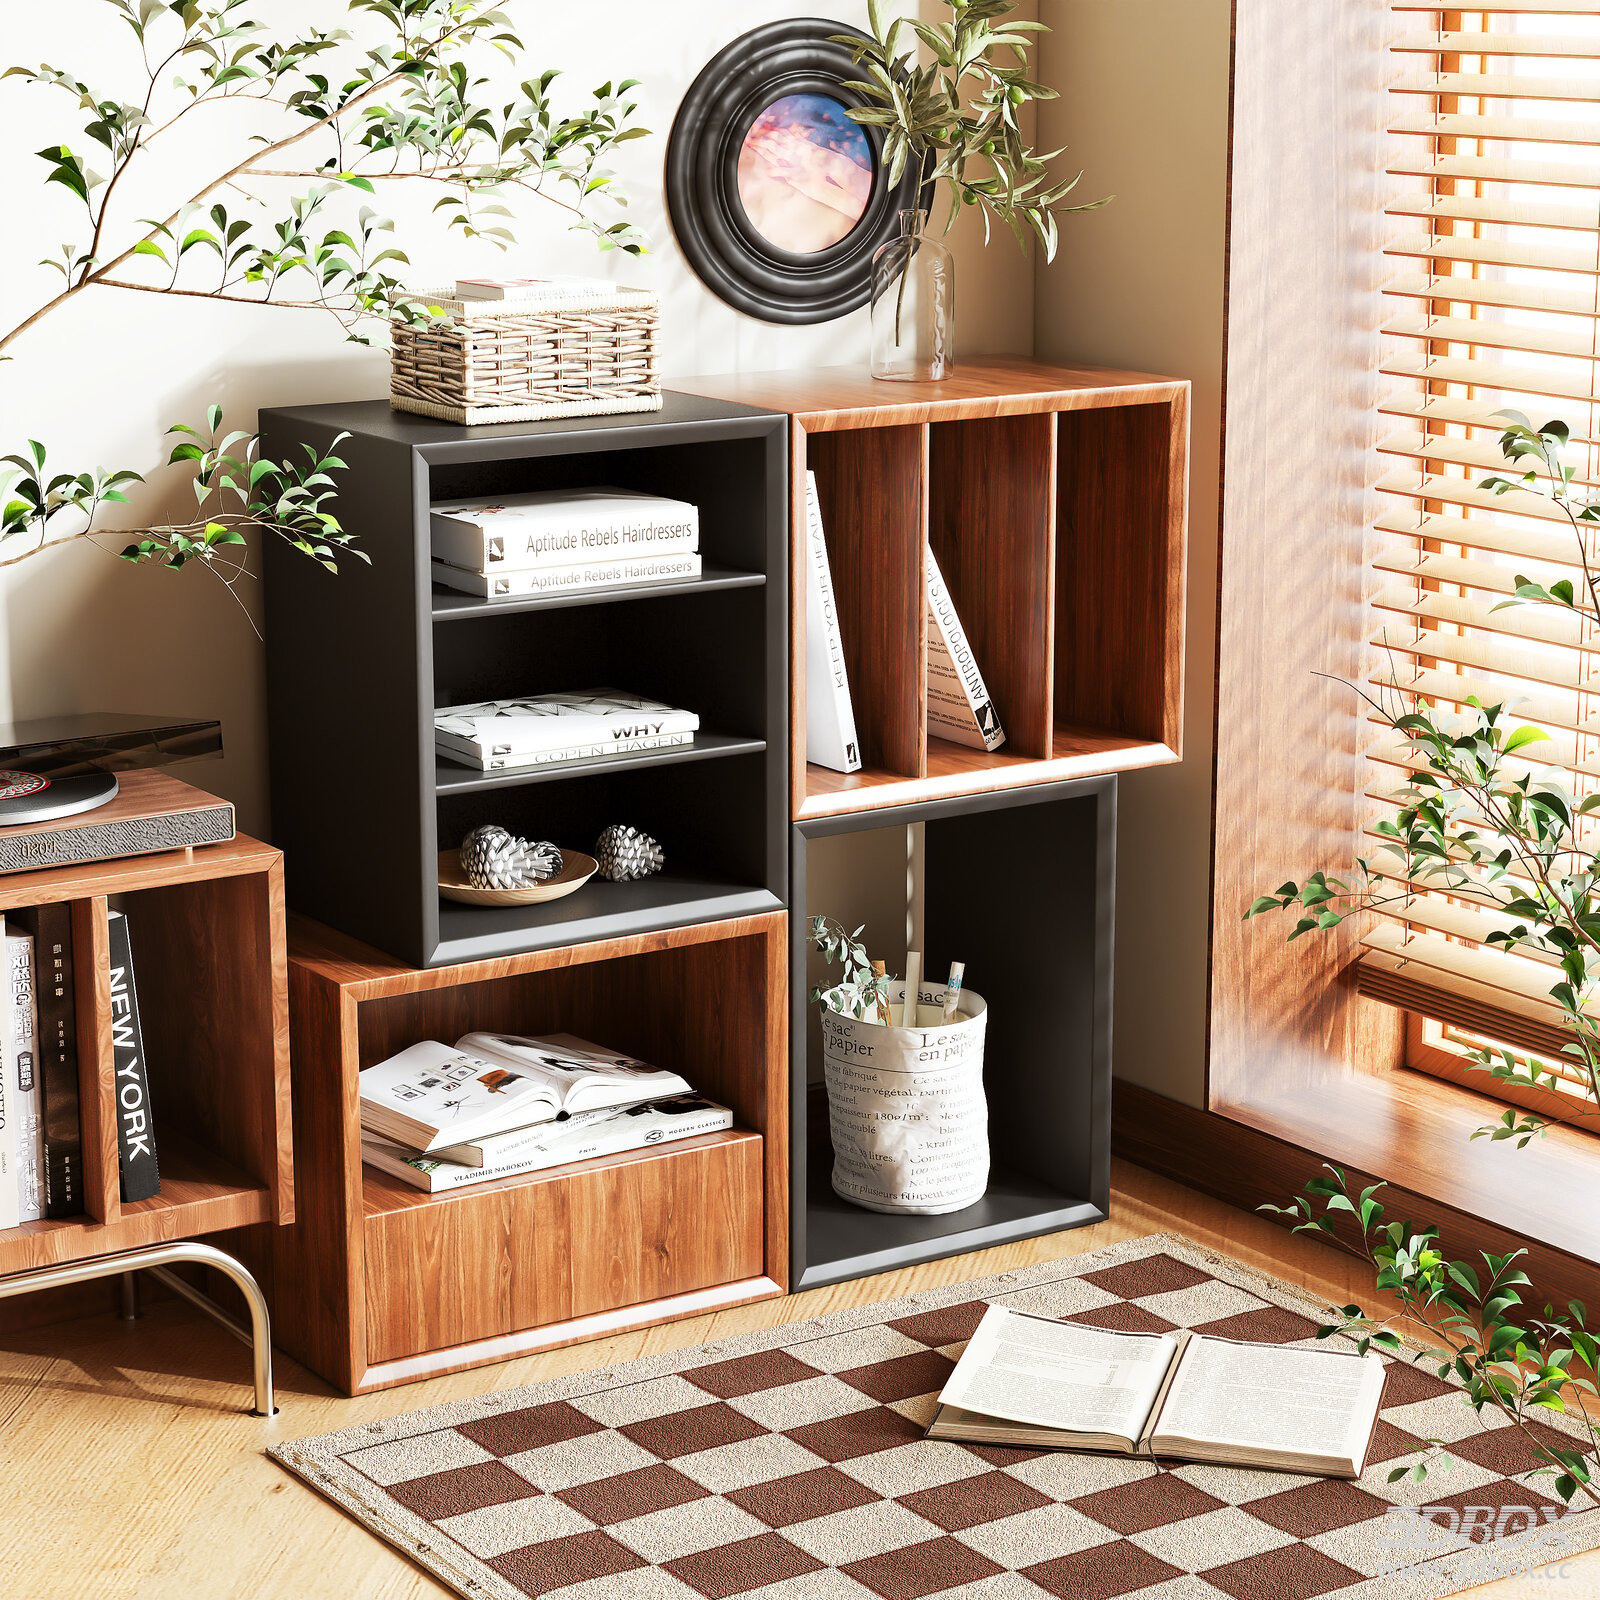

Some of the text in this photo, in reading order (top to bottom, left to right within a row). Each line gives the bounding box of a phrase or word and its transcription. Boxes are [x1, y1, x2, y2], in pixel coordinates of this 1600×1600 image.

[526, 522, 692, 558] Aptitude Rebels Hairdressers
[809, 511, 825, 570] HEAD
[531, 560, 692, 589] Aptitude Rebels Hairdressers
[819, 573, 834, 633] YOUR
[931, 584, 985, 699] ANTROPOLOGI'S
[829, 639, 844, 688] KEEP
[611, 722, 665, 739] WHY
[534, 735, 683, 763] COPEN HAGEN
[829, 1035, 874, 1057] papier
[919, 1033, 948, 1049] Le
[110, 966, 150, 1163] NEW YORK
[919, 1050, 940, 1062] en
[842, 1067, 877, 1081] fabriqué
[843, 1082, 871, 1094] papier
[846, 1121, 876, 1134] doublé
[454, 1168, 493, 1182] VLADIMIR
[494, 1160, 533, 1174] NABOKOV
[668, 1126, 695, 1135] MODERN
[697, 1119, 726, 1129] CLASSICS
[869, 1151, 896, 1163] litres.
[859, 1185, 898, 1200] plusieurs
